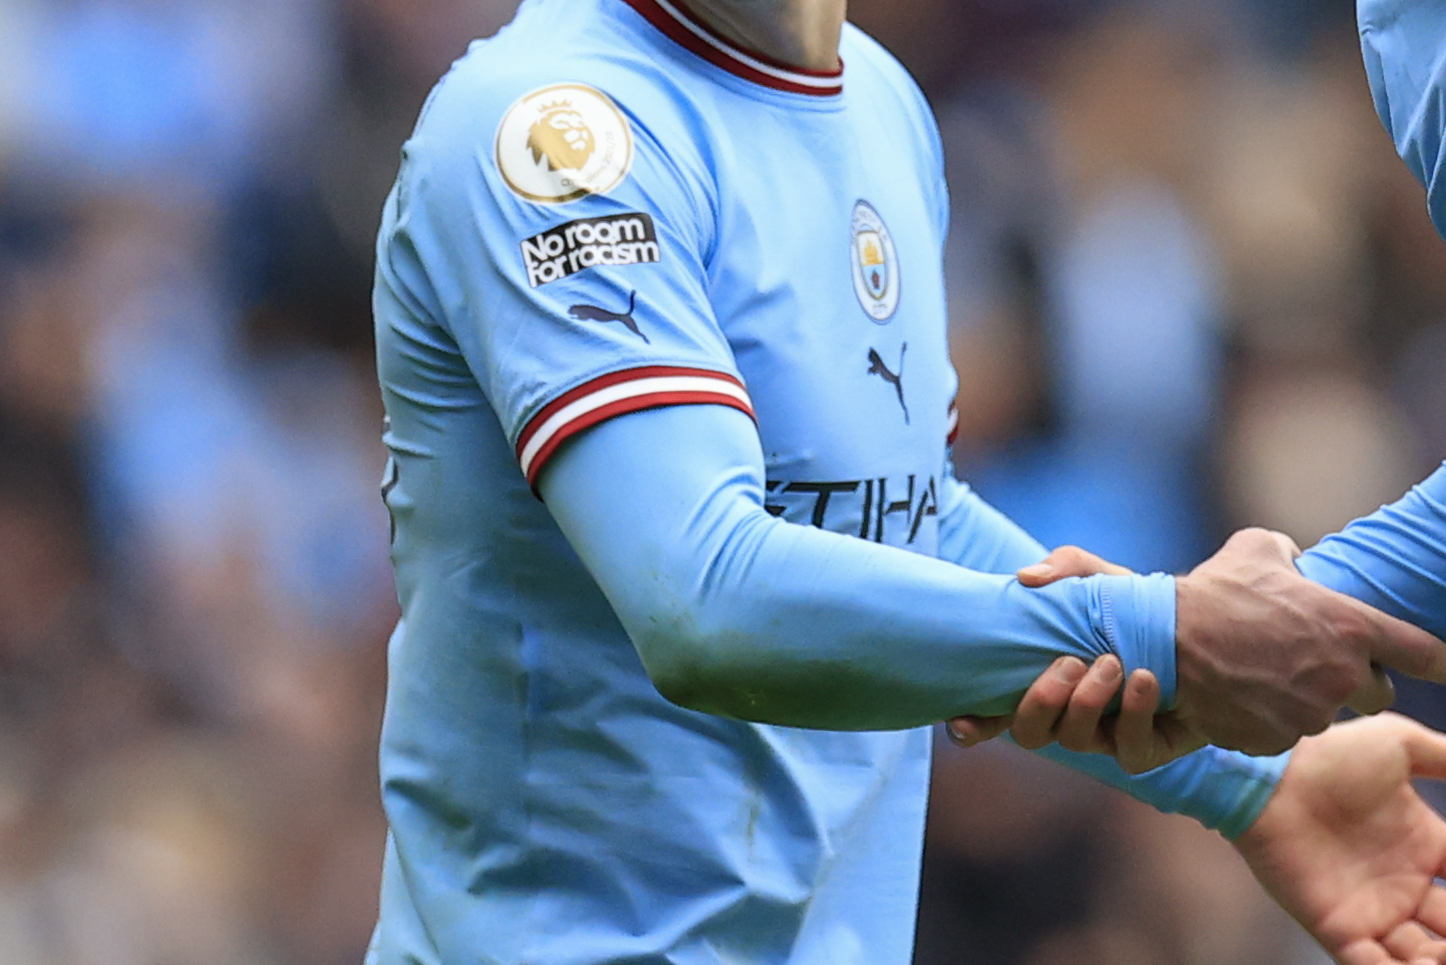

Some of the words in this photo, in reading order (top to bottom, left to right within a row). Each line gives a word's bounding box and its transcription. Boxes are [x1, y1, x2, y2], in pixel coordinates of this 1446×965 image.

[521, 234, 564, 267] No
[565, 218, 645, 250] room
[527, 253, 567, 288] for
[568, 241, 660, 273] racism
